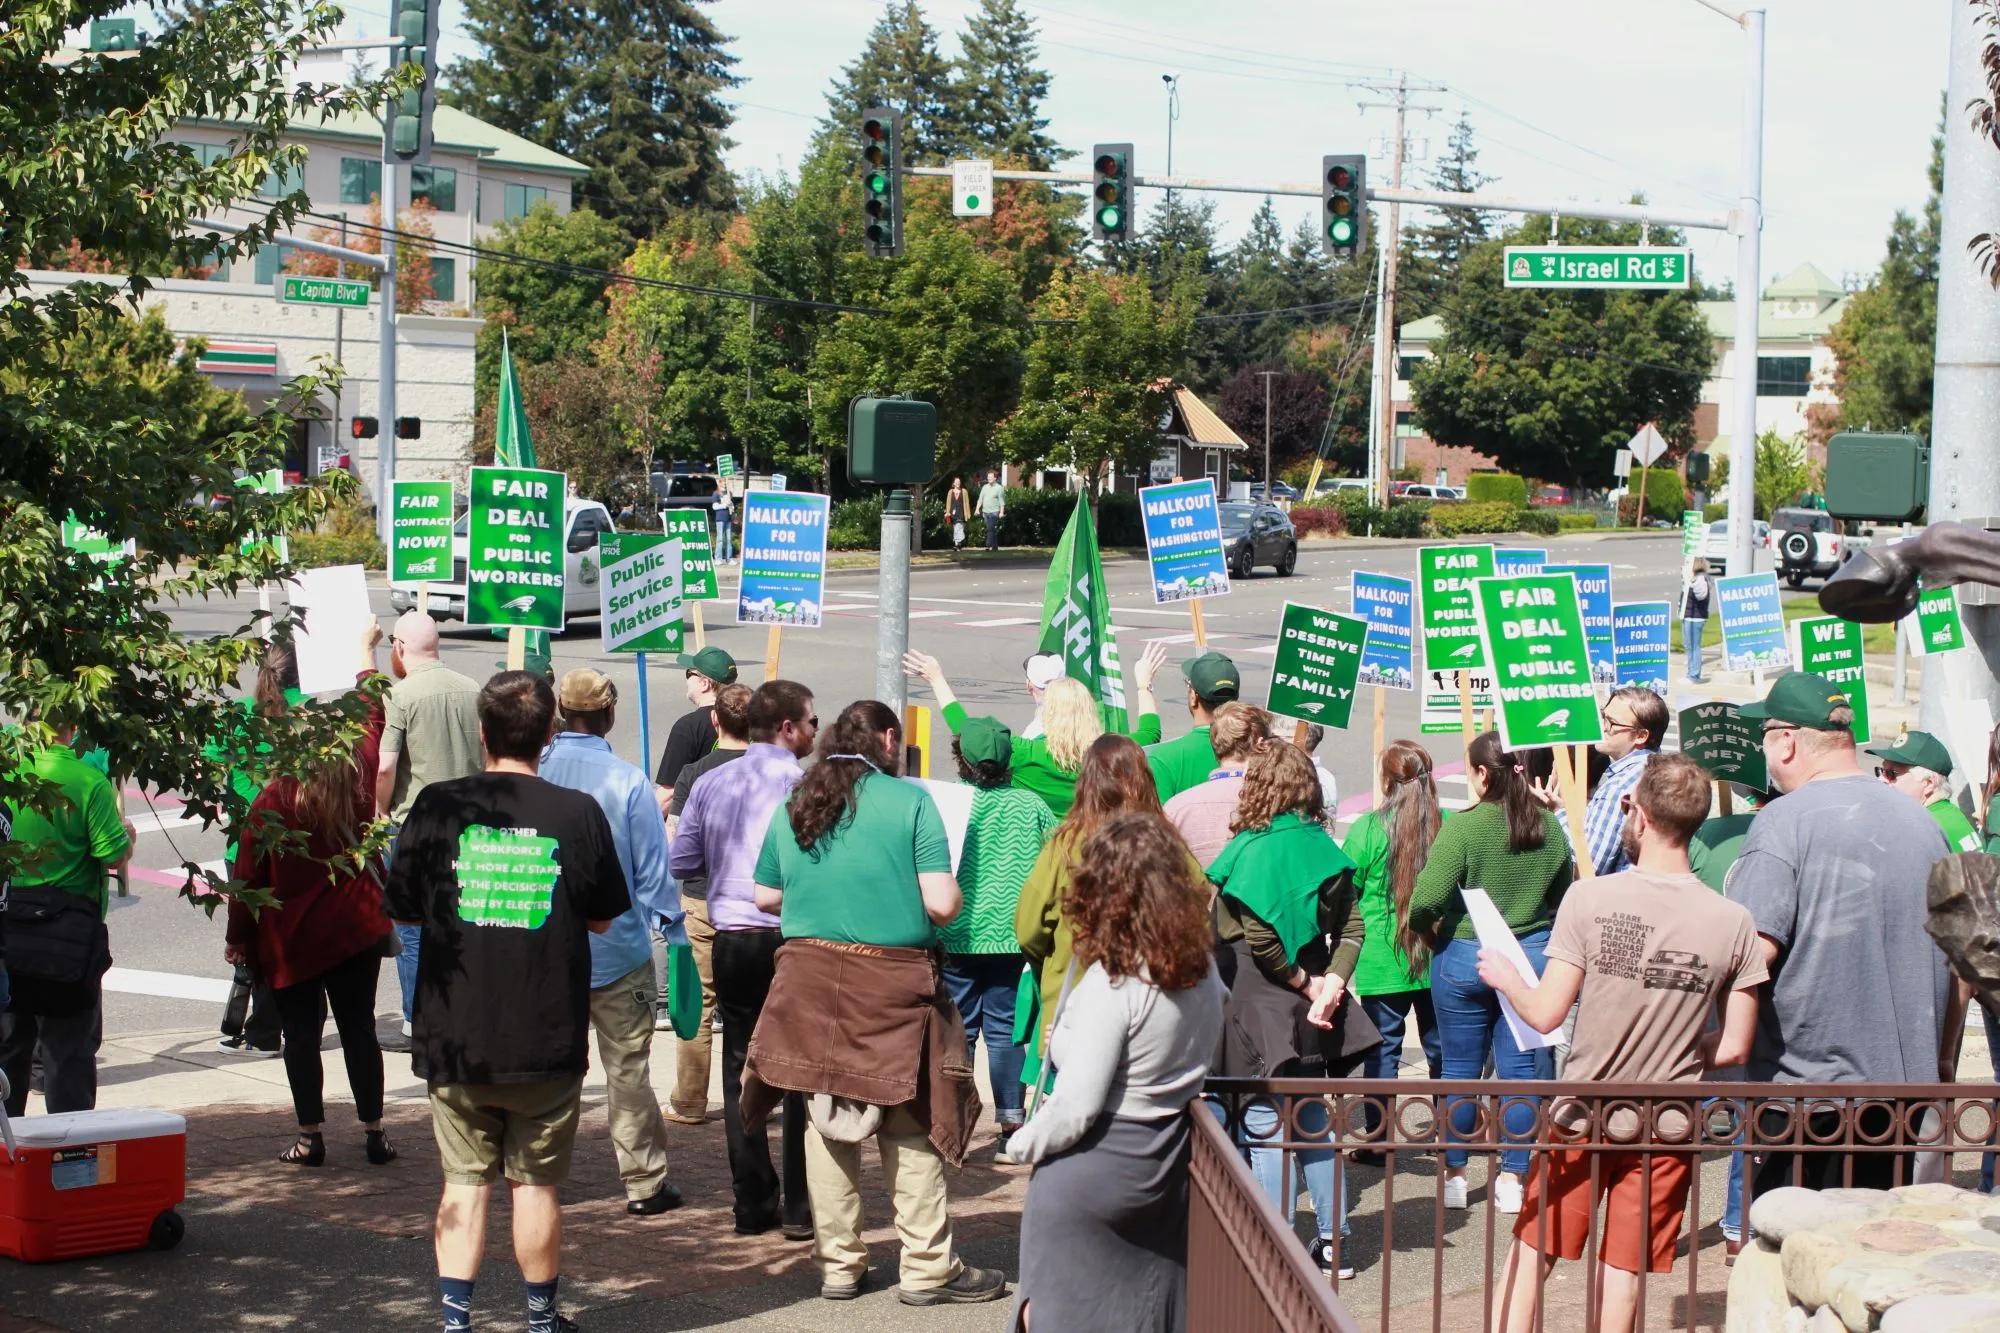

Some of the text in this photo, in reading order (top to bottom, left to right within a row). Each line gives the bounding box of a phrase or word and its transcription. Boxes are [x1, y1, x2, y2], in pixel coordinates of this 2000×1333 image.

[1541, 257, 1676, 279] SW Israel Rd SE
[300, 281, 333, 300] Capitol
[336, 284, 358, 300] Blvd
[492, 479, 548, 499] FAIR
[400, 496, 439, 508] FAIR
[1147, 494, 1212, 516] WALKOUT
[394, 518, 452, 526] CONTRACT
[488, 508, 550, 528] DEAL
[749, 507, 822, 526] WALKOUT
[1170, 516, 1194, 528] FOR
[669, 520, 705, 532] SAFE
[398, 536, 448, 549] NOW!
[508, 533, 531, 543] FOR
[771, 529, 796, 543] FOR
[1151, 529, 1218, 548] WASHINGTON
[484, 548, 552, 564] PUBLIC
[745, 548, 820, 563] WASHINGTON
[1434, 554, 1478, 569] FAIR
[610, 553, 664, 588] Public
[683, 560, 712, 572] OW!
[470, 569, 563, 587] WORKERS
[1434, 577, 1474, 592] DEA
[608, 575, 672, 614] Service
[1356, 586, 1410, 606] WALKOUT
[1500, 588, 1556, 608] FAIR
[1721, 584, 1775, 602] WALKOUT
[1374, 606, 1393, 618] FOR
[1740, 602, 1760, 612] FOR
[1920, 598, 1952, 616] NOW!
[610, 596, 682, 638] Matters
[1312, 616, 1338, 632] WE
[1616, 614, 1667, 628] WALKOUT
[1724, 613, 1780, 628] WASHINGTON
[1368, 622, 1410, 637] SHINGTON
[1425, 625, 1480, 638] WORKE
[1502, 618, 1568, 640] DEAL
[1630, 630, 1648, 640] FOR
[1812, 623, 1845, 642] WE
[1286, 628, 1358, 654] DESERVE
[1529, 645, 1552, 654] FOR
[1812, 650, 1852, 663] ARE THE
[1298, 648, 1336, 666] TIME
[1302, 665, 1330, 678] WITH
[1508, 660, 1576, 678] PUBLIC
[1276, 672, 1352, 700] FAMILY
[1501, 683, 1594, 702] WORKERS
[1696, 706, 1740, 719] WE
[1693, 723, 1750, 734] ARE THE
[1684, 734, 1764, 752] SAFETY
[1704, 750, 1746, 761] NET
[500, 827, 538, 837] OTHER
[470, 844, 542, 856] WORKFORCE
[452, 860, 562, 876] HAS MORE AT STAKE
[458, 880, 553, 892] IN THE DECISIONS
[458, 898, 551, 910] MADE BY ELECTED
[476, 917, 530, 928] OFFICIALS
[1594, 916, 1656, 933] OPPORTUNITY
[1620, 912, 1642, 923] RARE
[1601, 932, 1646, 946] PRACTICAL
[1615, 927, 1639, 937] MAKE
[1600, 940, 1644, 952] PURCHASE
[1600, 946, 1642, 960] BASED ON
[1594, 960, 1644, 974] EMOTIONAL
[1608, 955, 1640, 966] PURELY
[1598, 967, 1638, 980] DECISION.
